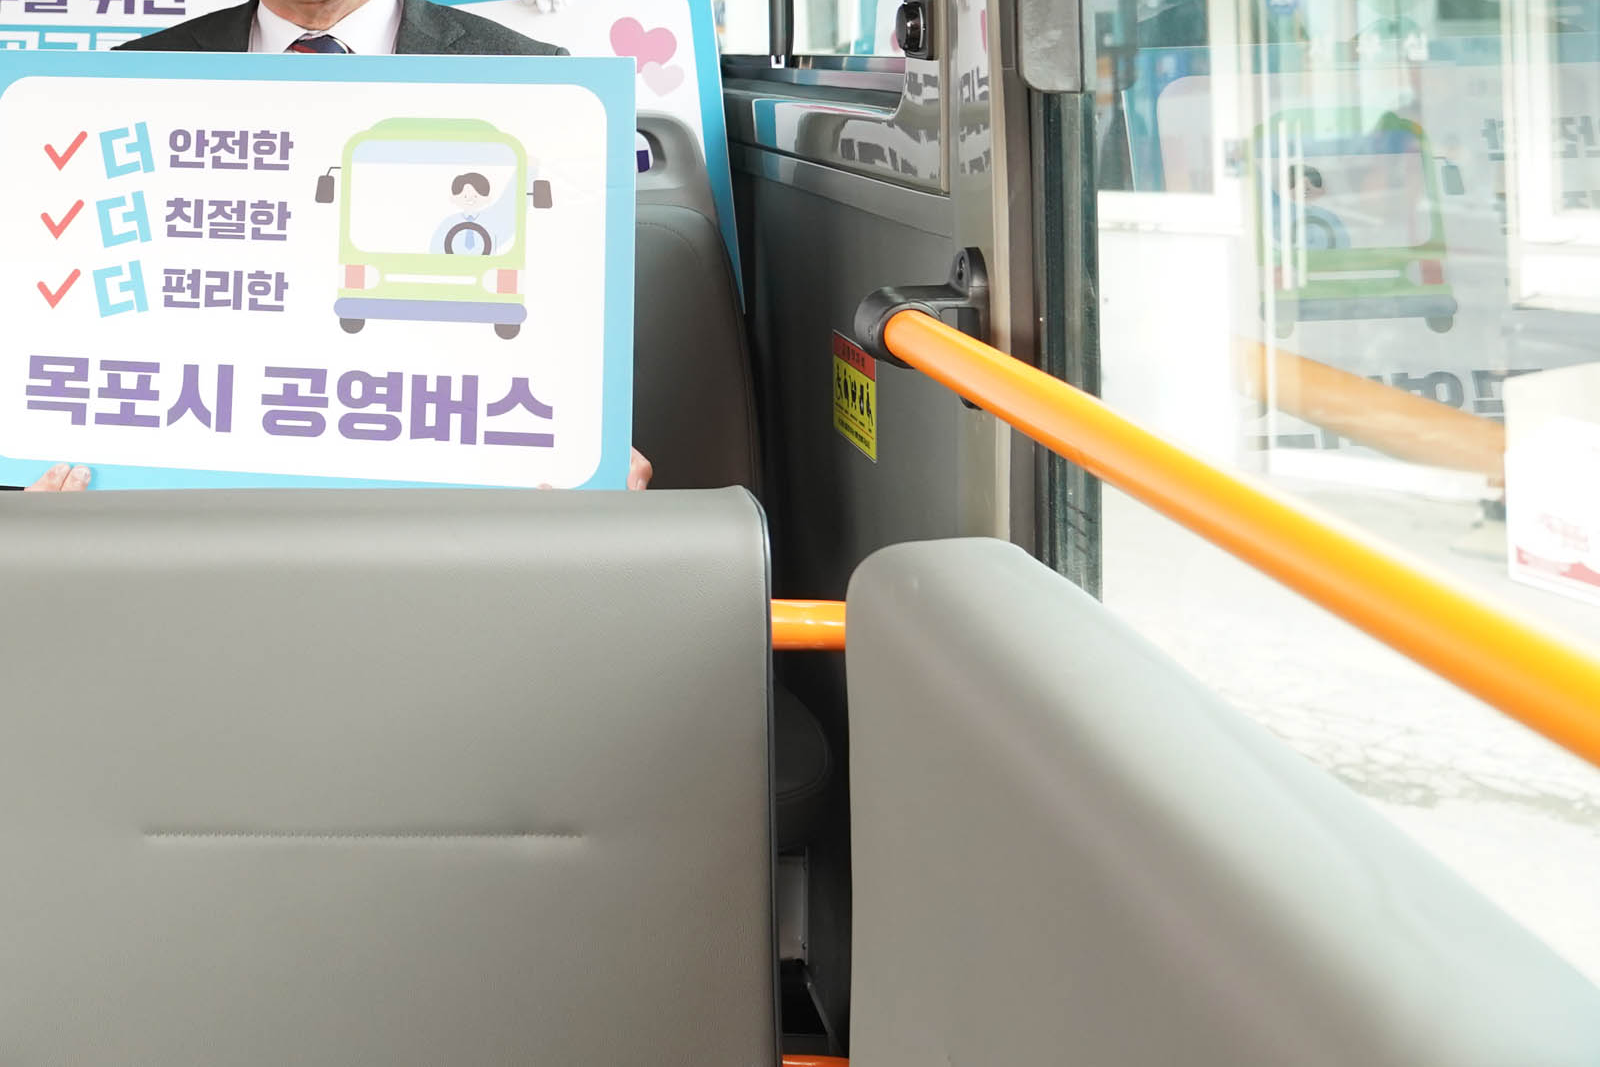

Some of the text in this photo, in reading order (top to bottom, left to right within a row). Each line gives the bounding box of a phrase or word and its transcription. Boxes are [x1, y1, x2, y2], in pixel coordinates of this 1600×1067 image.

[98, 121, 295, 179] 더 안전한
[95, 190, 292, 249] 더 친절한
[92, 259, 289, 318] 더 편리한
[25, 354, 555, 448] 목포시 공영버스
